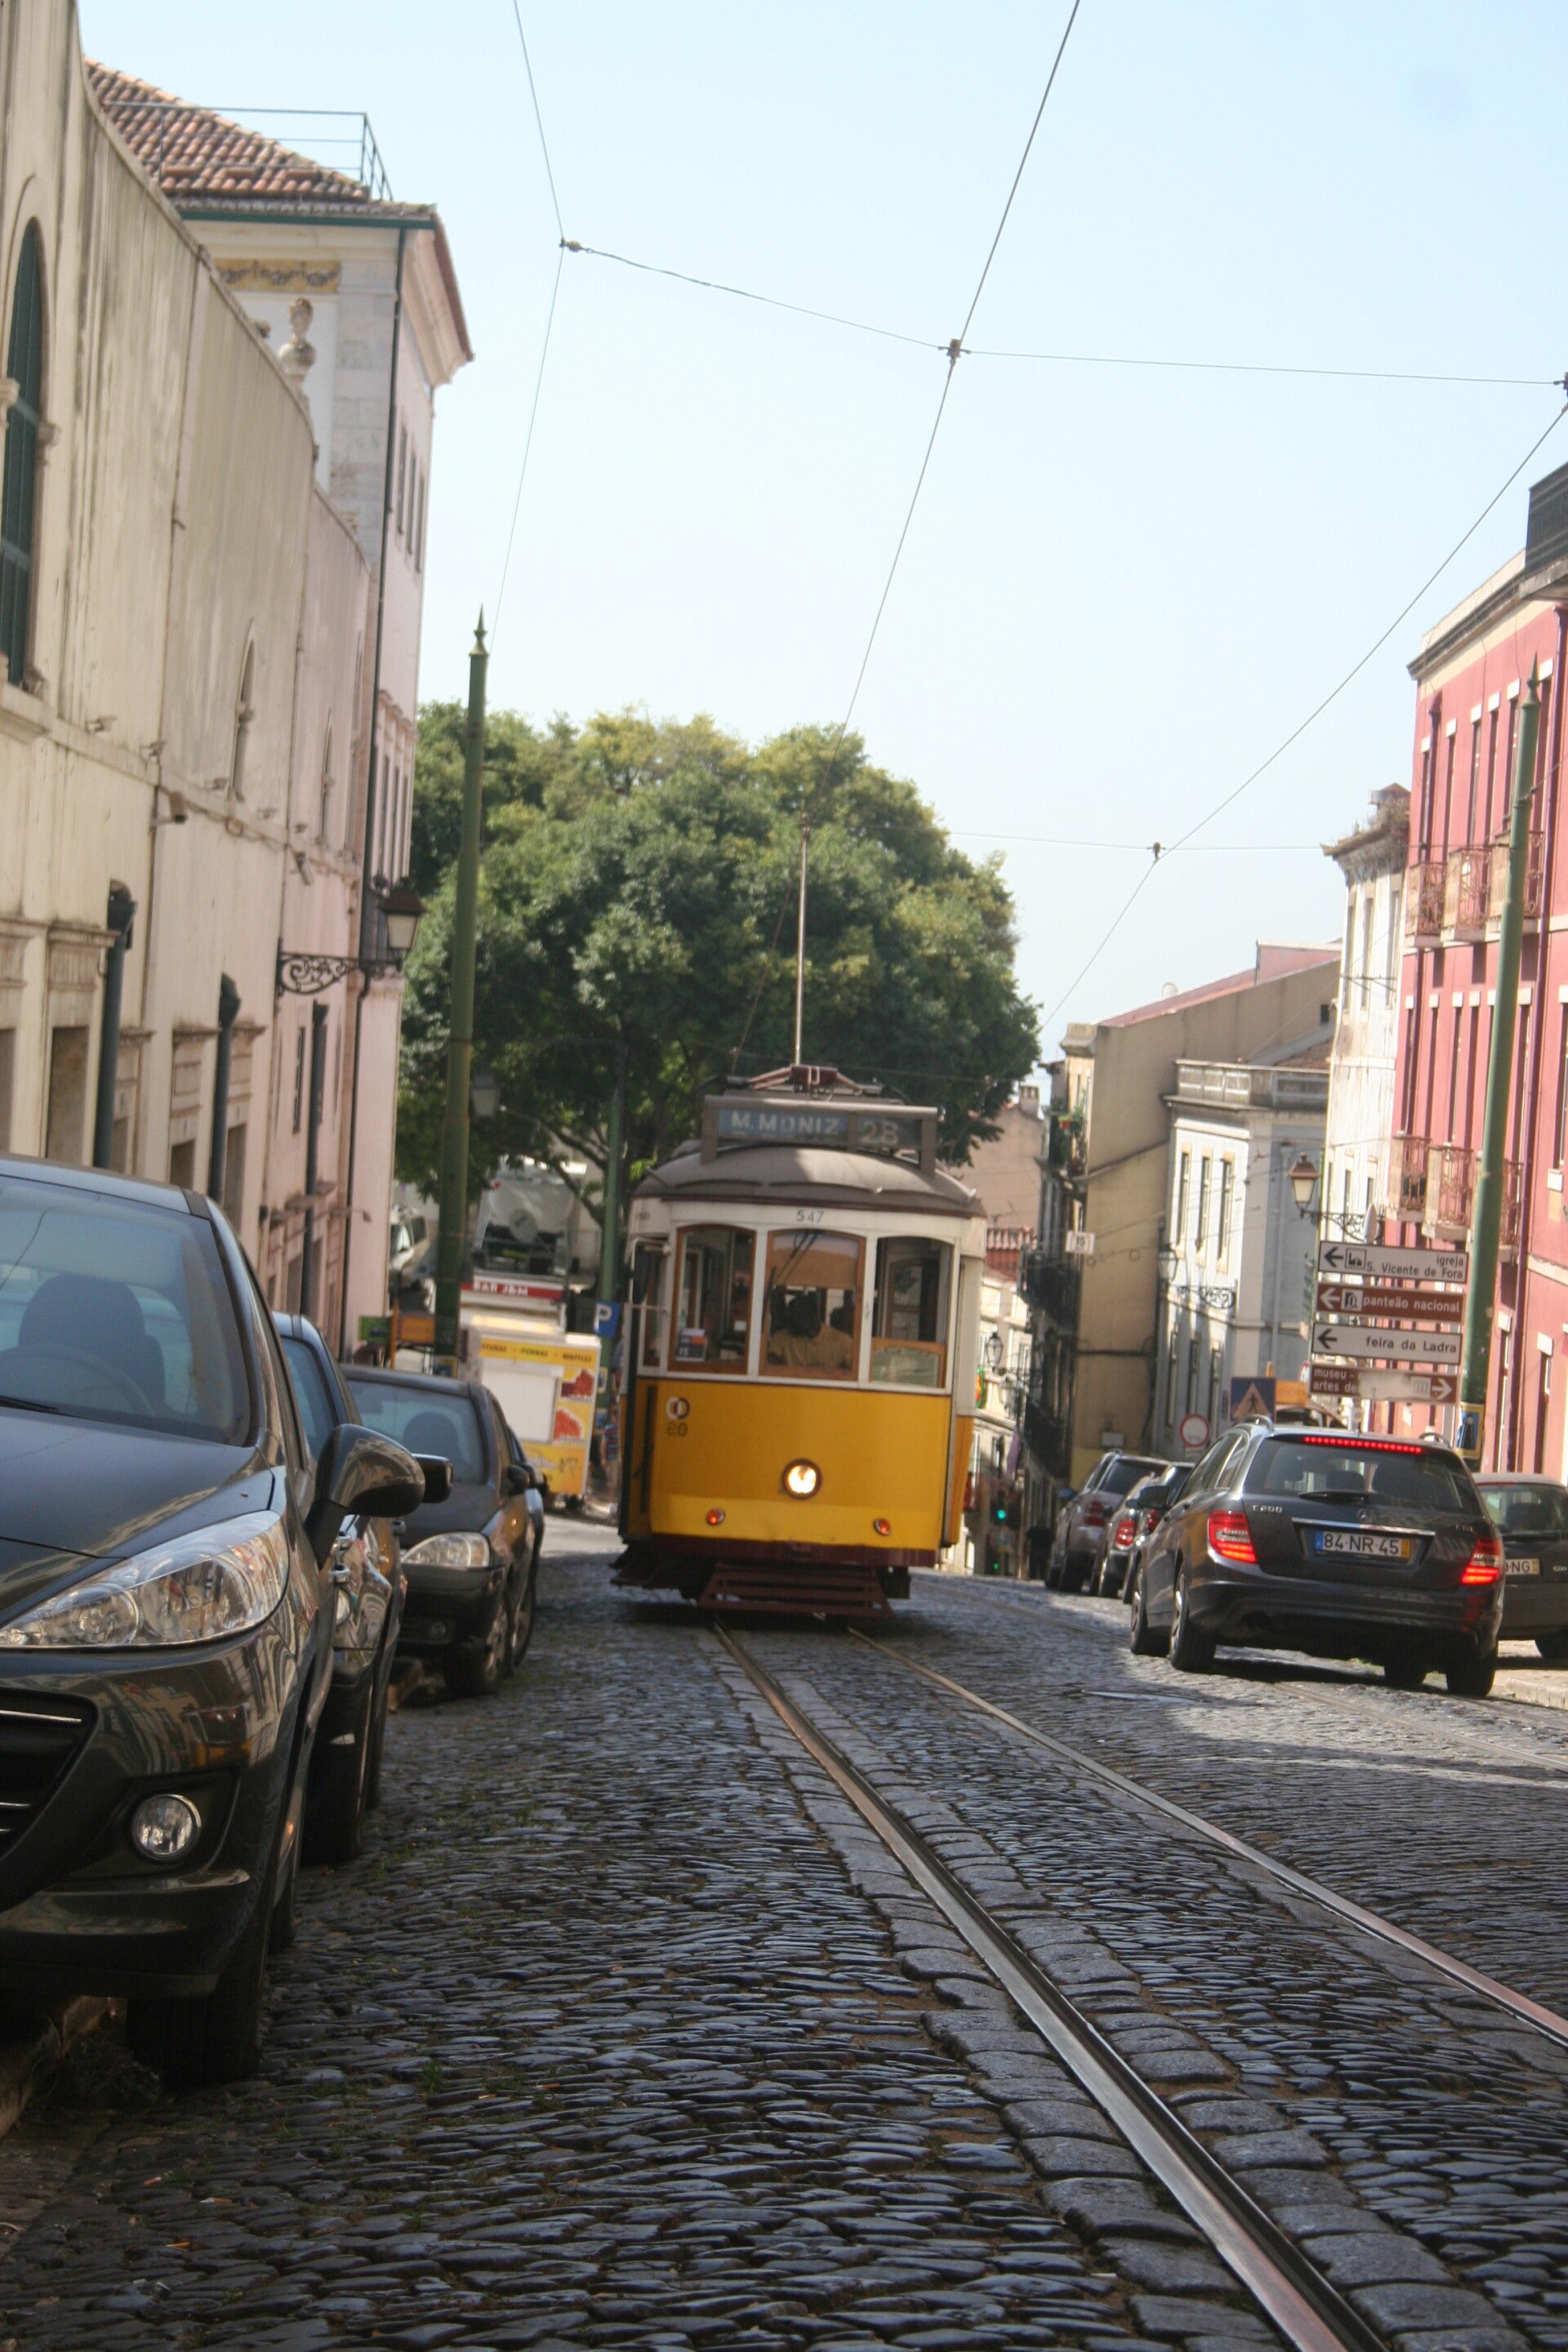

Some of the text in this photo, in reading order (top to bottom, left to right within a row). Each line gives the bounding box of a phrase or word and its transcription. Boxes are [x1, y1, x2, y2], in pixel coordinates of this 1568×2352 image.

[862, 1120, 898, 1145] 28
[796, 1209, 824, 1223] 547
[1437, 1255, 1464, 1267] igreja
[1366, 1262, 1463, 1279] S. Vicente de Fora
[1363, 1294, 1460, 1313] panteão nacional
[594, 1307, 612, 1330] P
[1365, 1336, 1457, 1353] feira da Ladra
[1314, 1368, 1347, 1380] museu
[1313, 1380, 1357, 1394] artes de
